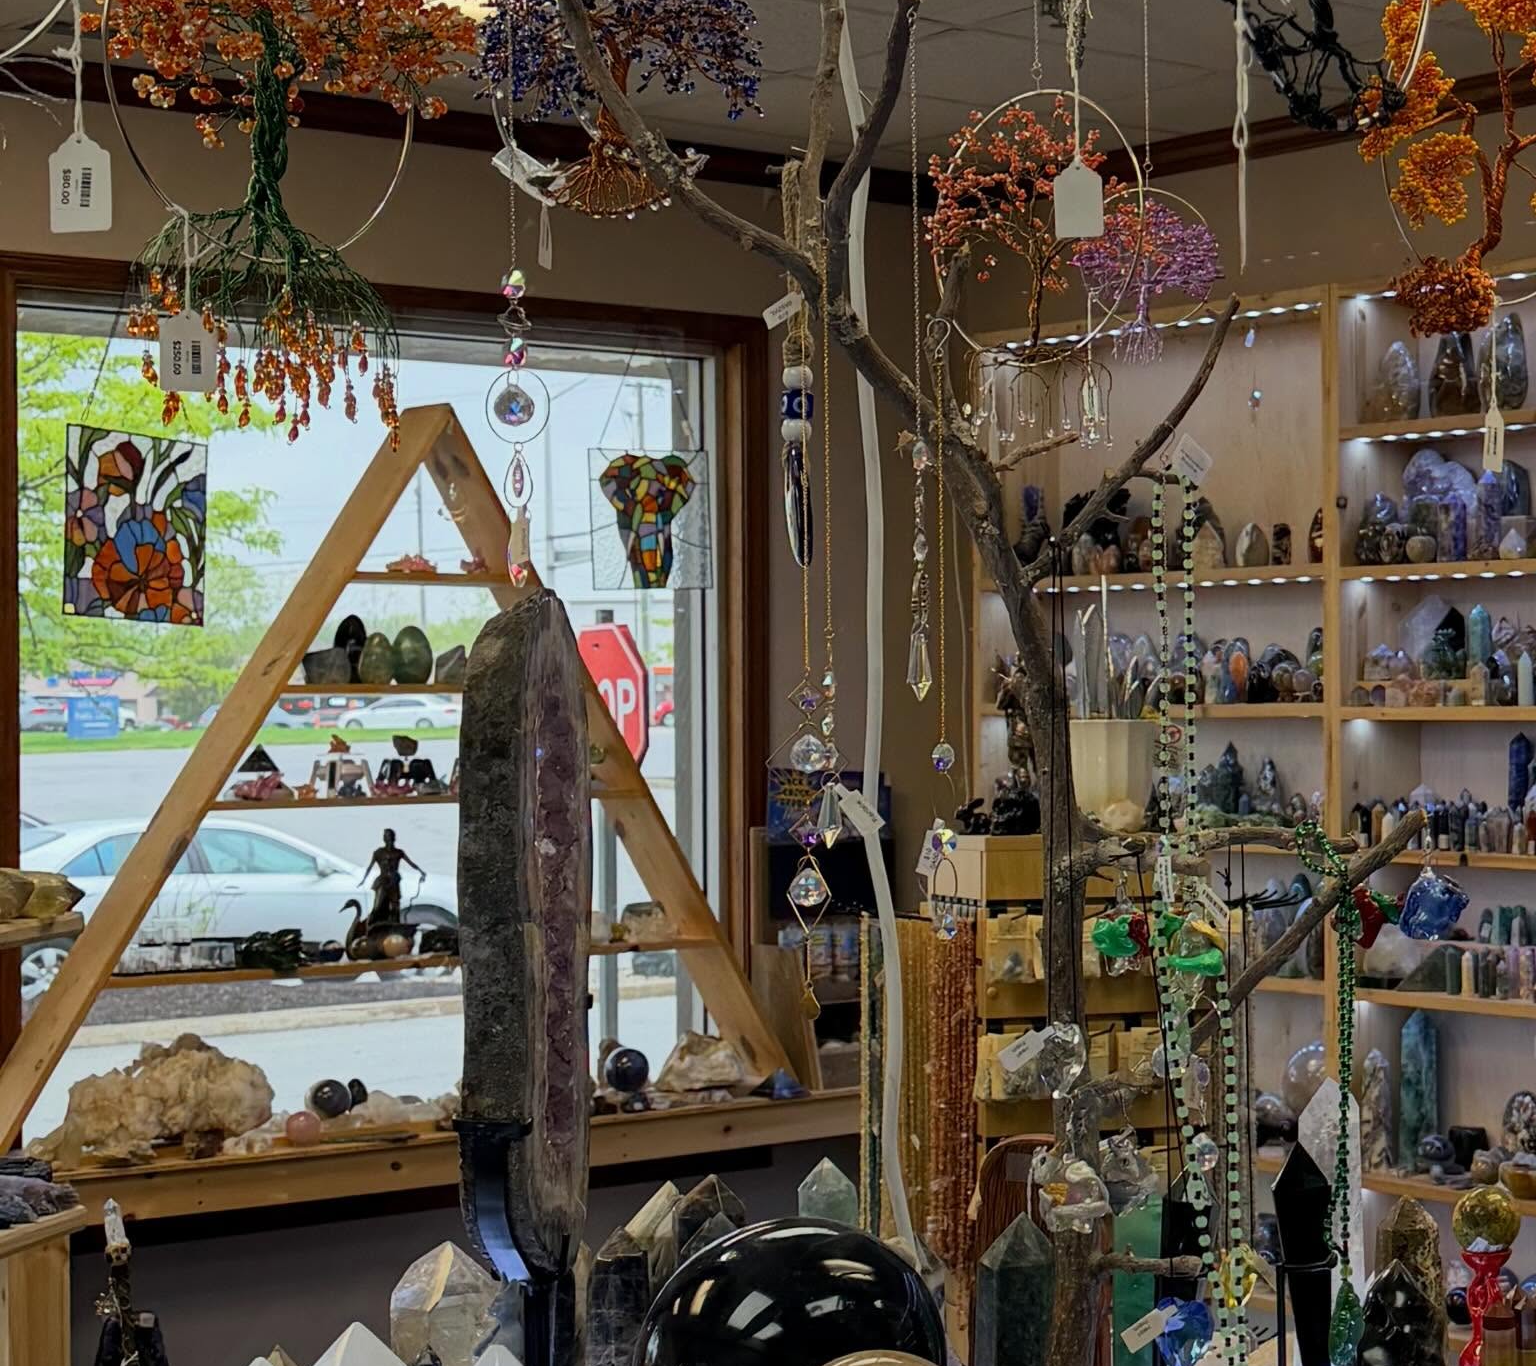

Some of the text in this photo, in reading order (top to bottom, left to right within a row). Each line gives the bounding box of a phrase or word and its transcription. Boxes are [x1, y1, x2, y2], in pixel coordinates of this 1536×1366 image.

[61, 169, 72, 205] $80.00
[173, 340, 182, 375] $250.00
[597, 678, 636, 736] OP
